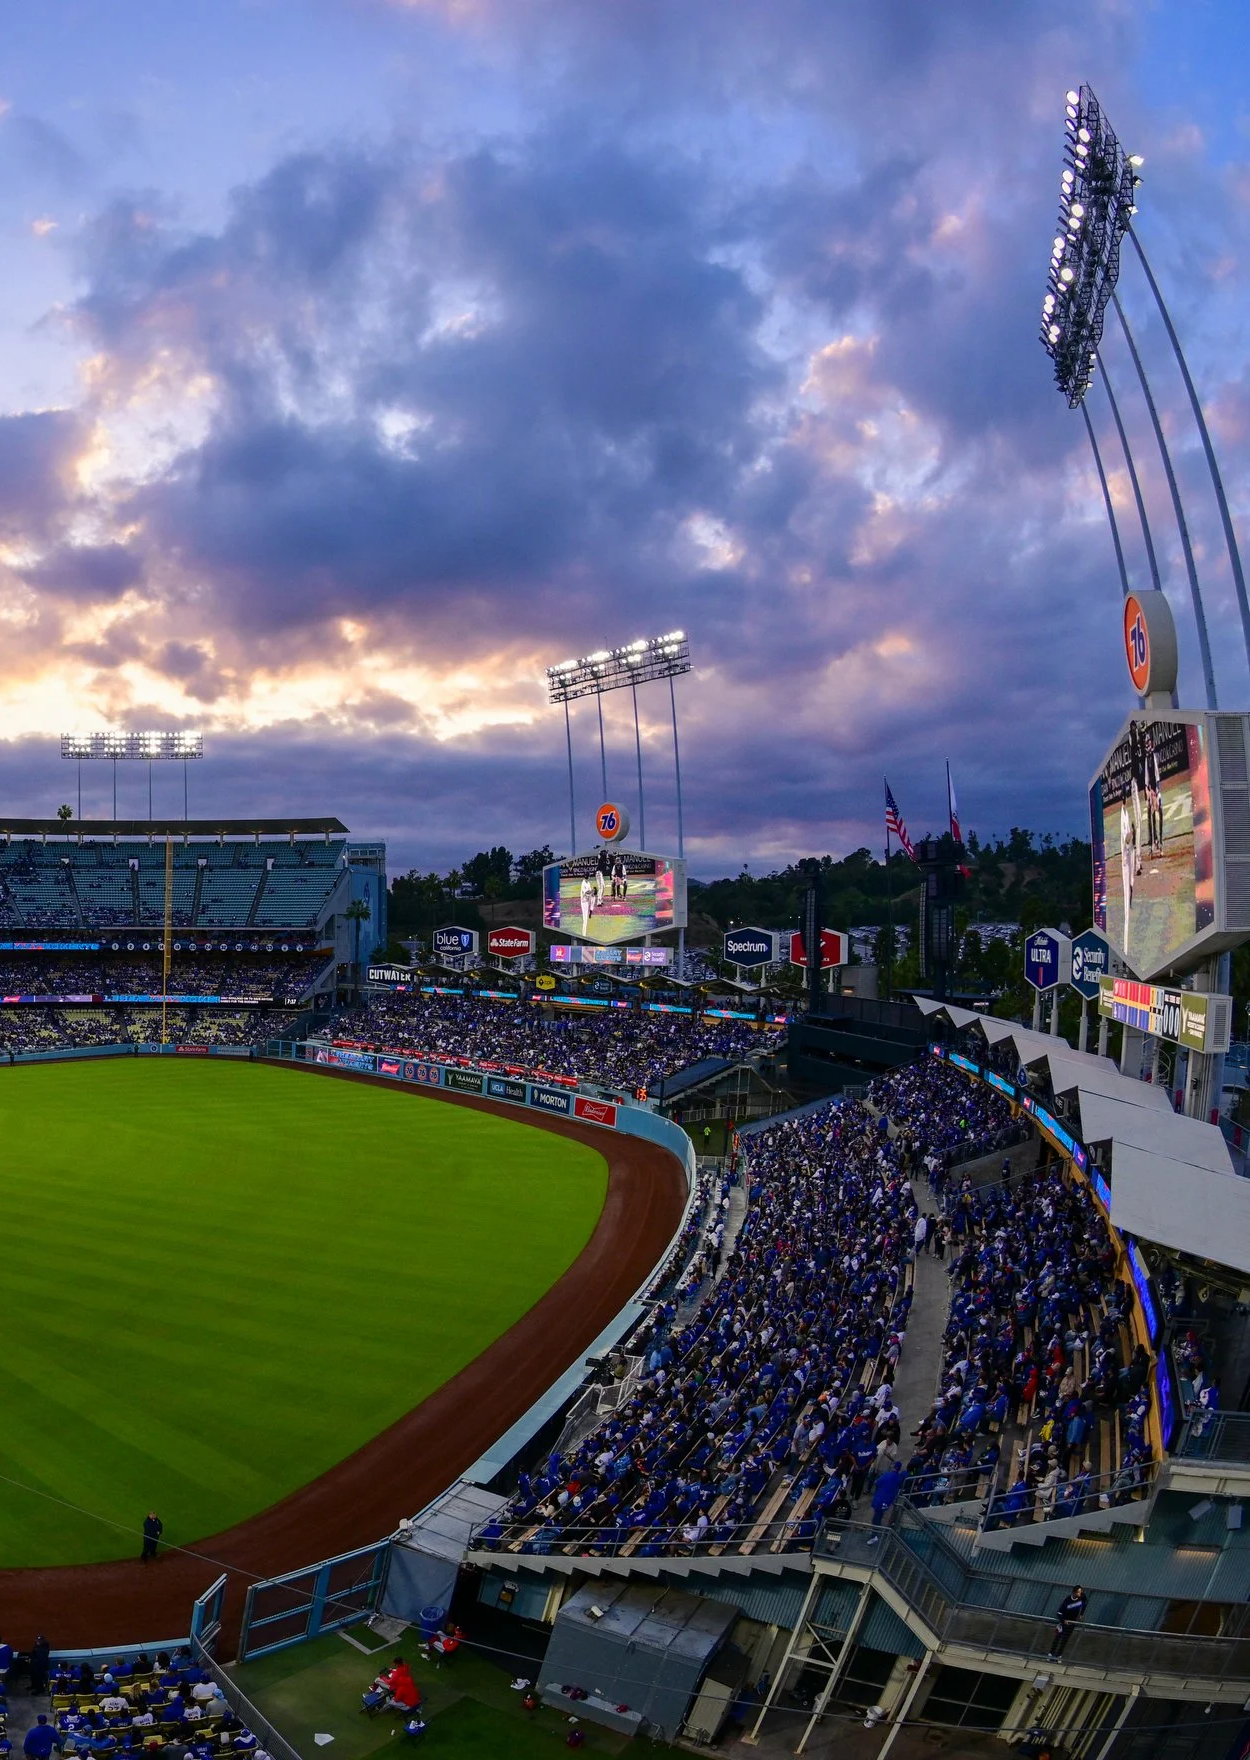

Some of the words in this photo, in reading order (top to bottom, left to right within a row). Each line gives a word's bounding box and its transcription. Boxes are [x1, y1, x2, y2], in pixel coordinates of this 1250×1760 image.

[1129, 612, 1147, 672] 76
[600, 811, 616, 832] 76
[436, 933, 459, 945] blue
[727, 940, 766, 954] Spectrum
[1031, 948, 1052, 964] ULTRA
[1084, 947, 1105, 968] Security
[369, 969, 411, 981] CUTWATER
[405, 1066, 414, 1075] 76
[417, 1069, 426, 1077] 76
[430, 1071, 438, 1079] 76
[491, 1082, 504, 1092] UCLA
[506, 1085, 524, 1097] Health
[540, 1093, 567, 1109] MORTON
[584, 1105, 606, 1116] Budweiser
